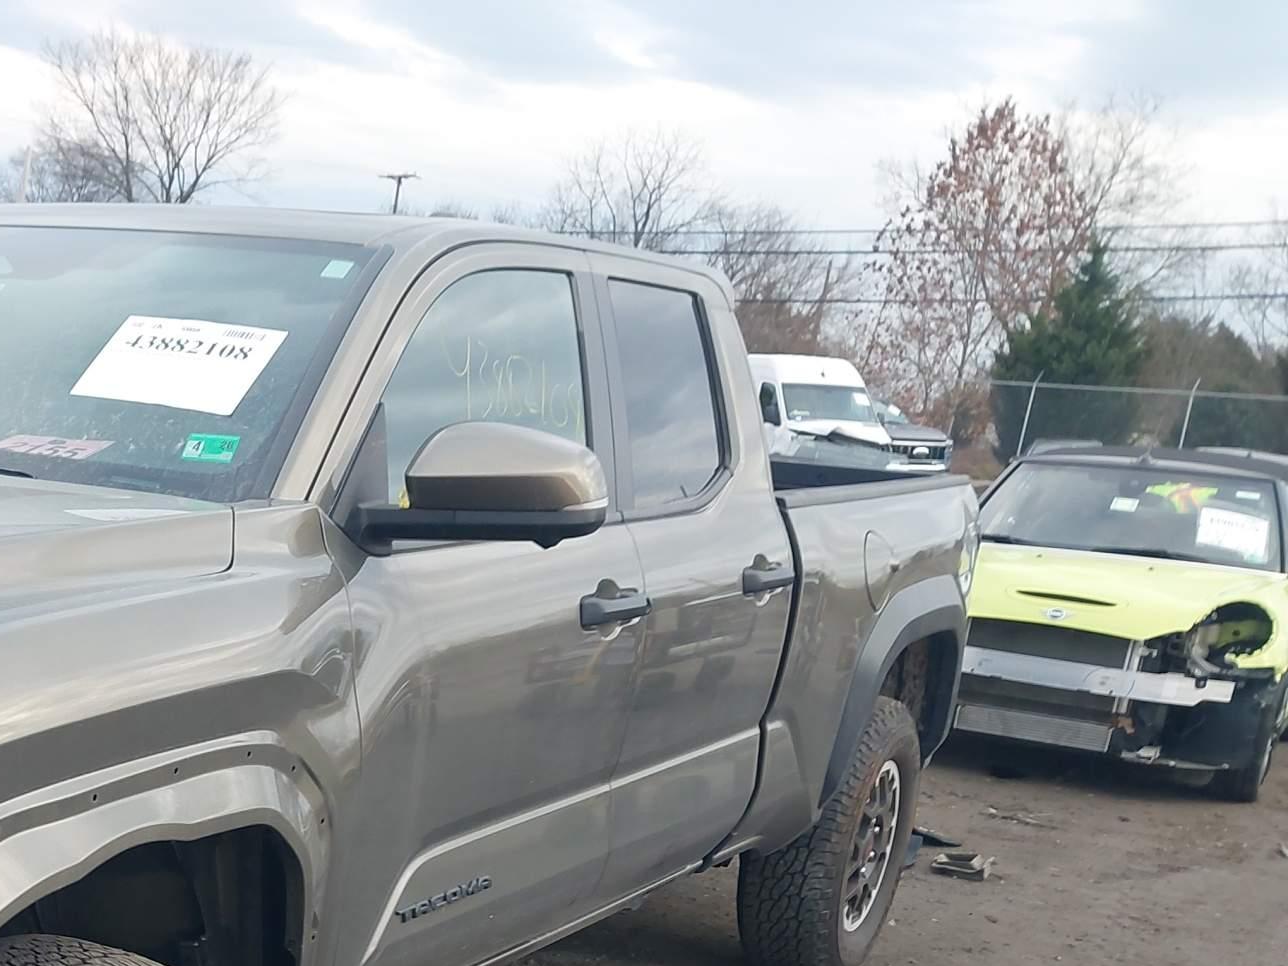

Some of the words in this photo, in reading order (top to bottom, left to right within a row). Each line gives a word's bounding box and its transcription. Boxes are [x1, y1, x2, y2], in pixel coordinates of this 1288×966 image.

[125, 333, 253, 360] 43882108
[191, 440, 202, 452] 4
[394, 875, 492, 923] TACOMA
